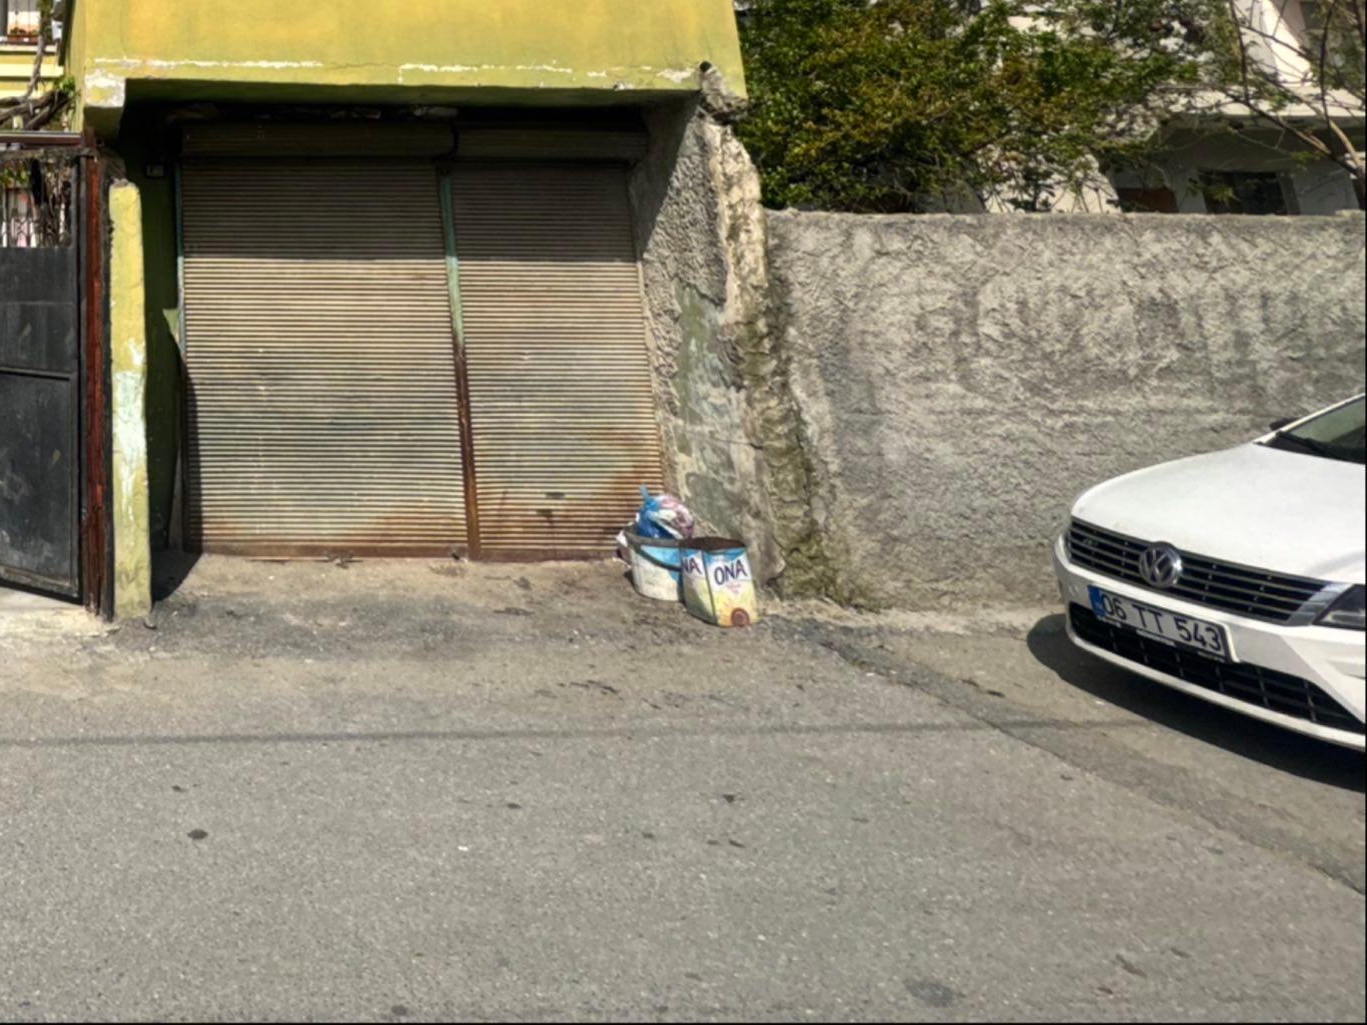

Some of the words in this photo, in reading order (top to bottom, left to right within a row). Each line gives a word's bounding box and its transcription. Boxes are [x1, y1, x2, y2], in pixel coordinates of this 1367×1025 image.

[1102, 593, 1127, 620] 06
[1132, 604, 1163, 633] TT
[1174, 617, 1222, 651] 543
